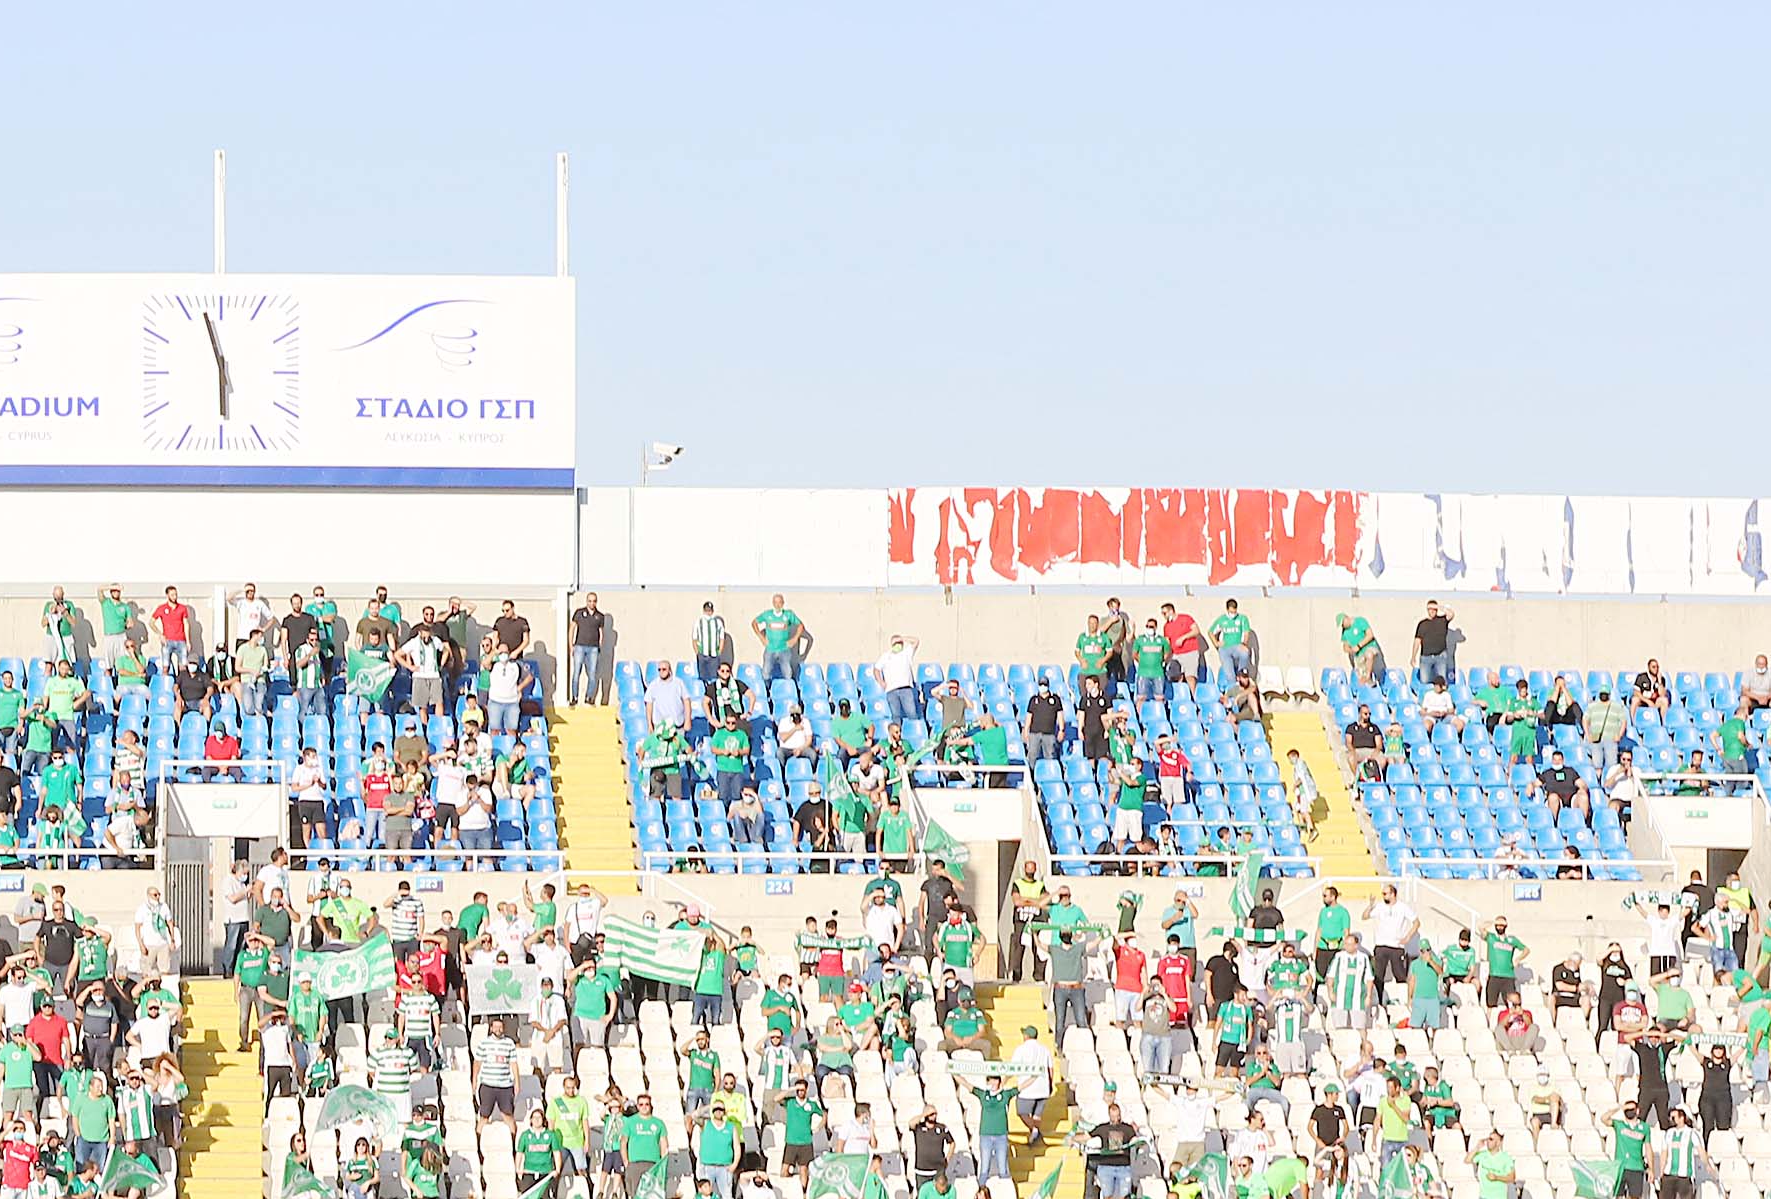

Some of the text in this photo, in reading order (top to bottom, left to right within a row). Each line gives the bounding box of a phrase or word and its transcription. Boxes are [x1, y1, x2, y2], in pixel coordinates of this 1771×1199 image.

[355, 397, 535, 421] ΣΤΑΔΙΟ ΓΣΠ
[8, 430, 53, 442] CYPRUS
[766, 881, 791, 894] 224
